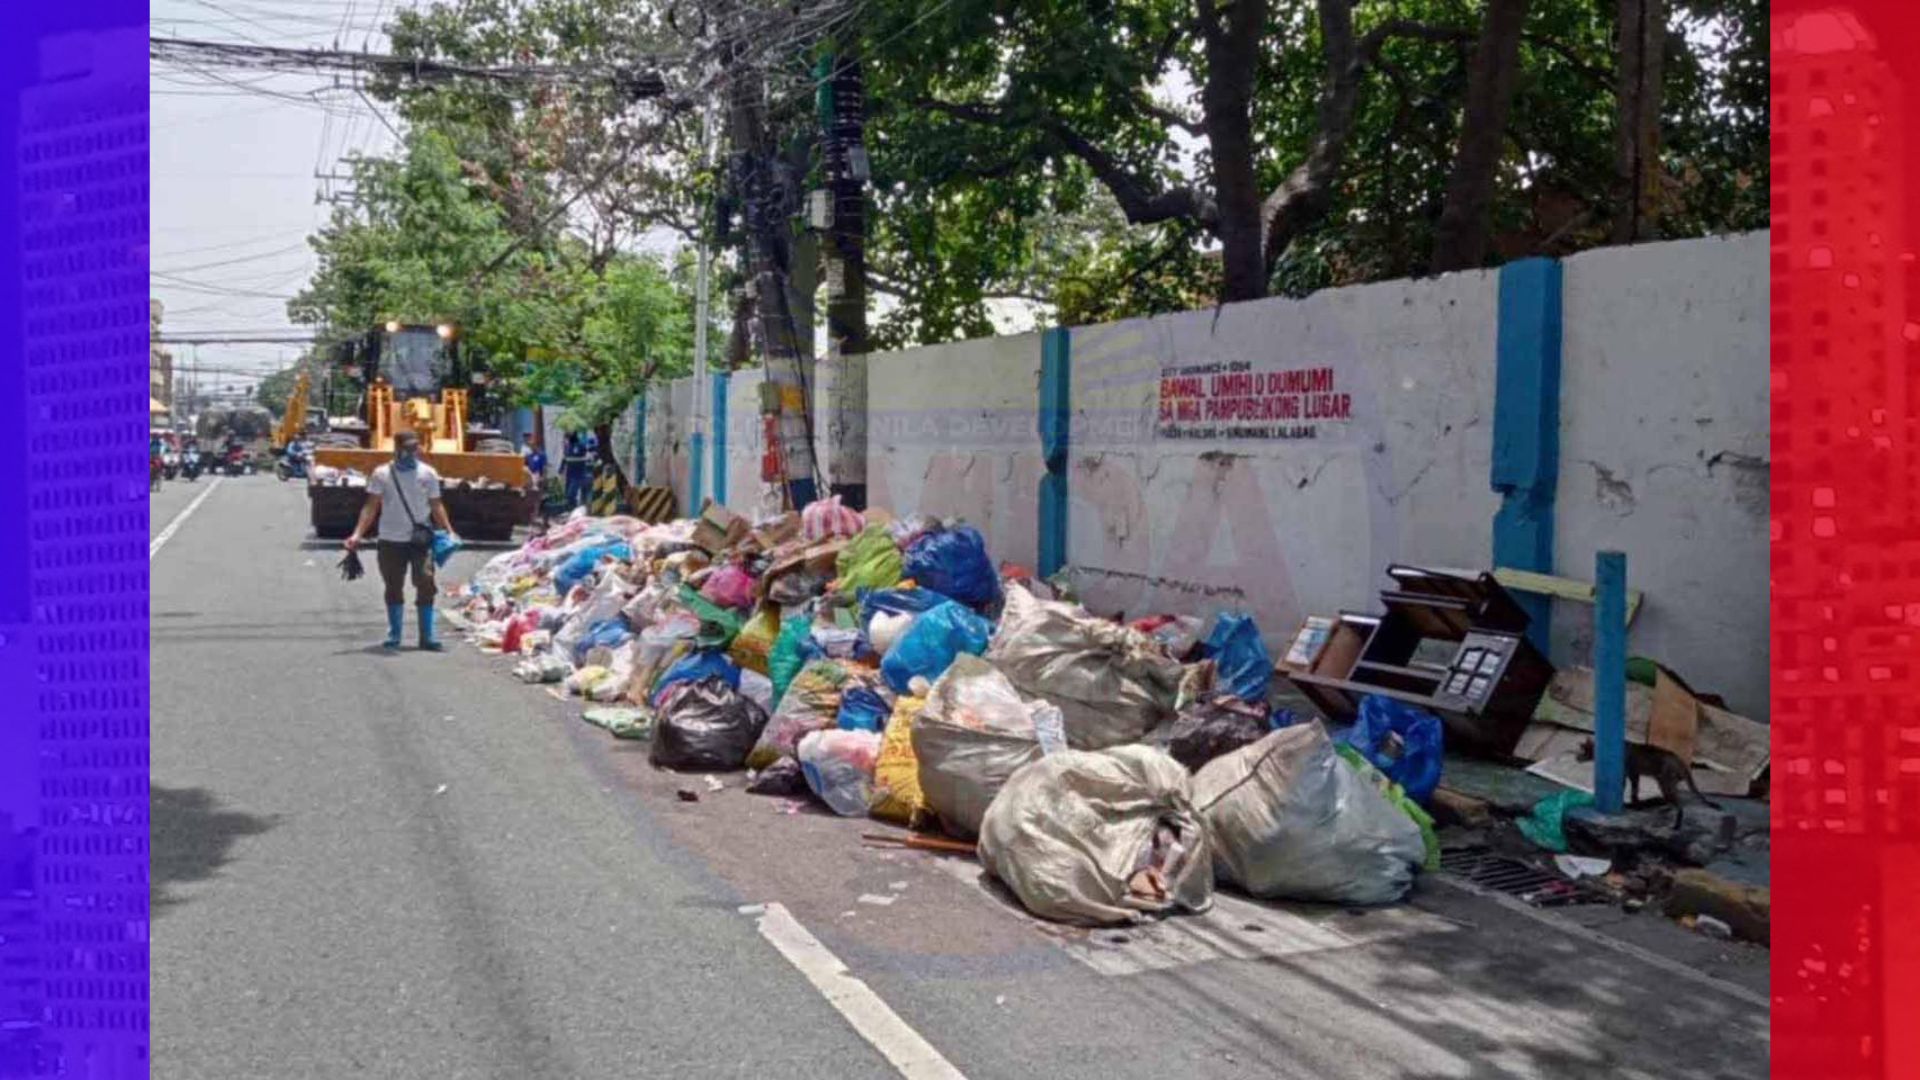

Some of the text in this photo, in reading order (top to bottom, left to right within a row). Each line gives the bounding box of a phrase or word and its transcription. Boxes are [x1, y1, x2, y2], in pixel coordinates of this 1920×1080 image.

[1160, 375, 1205, 398] BAWAL
[1211, 373, 1252, 397] UMIHI
[1267, 368, 1334, 395] DUMUMI
[1159, 400, 1173, 421] SA
[1176, 398, 1201, 421] MGA
[1303, 393, 1352, 420] LUGAR
